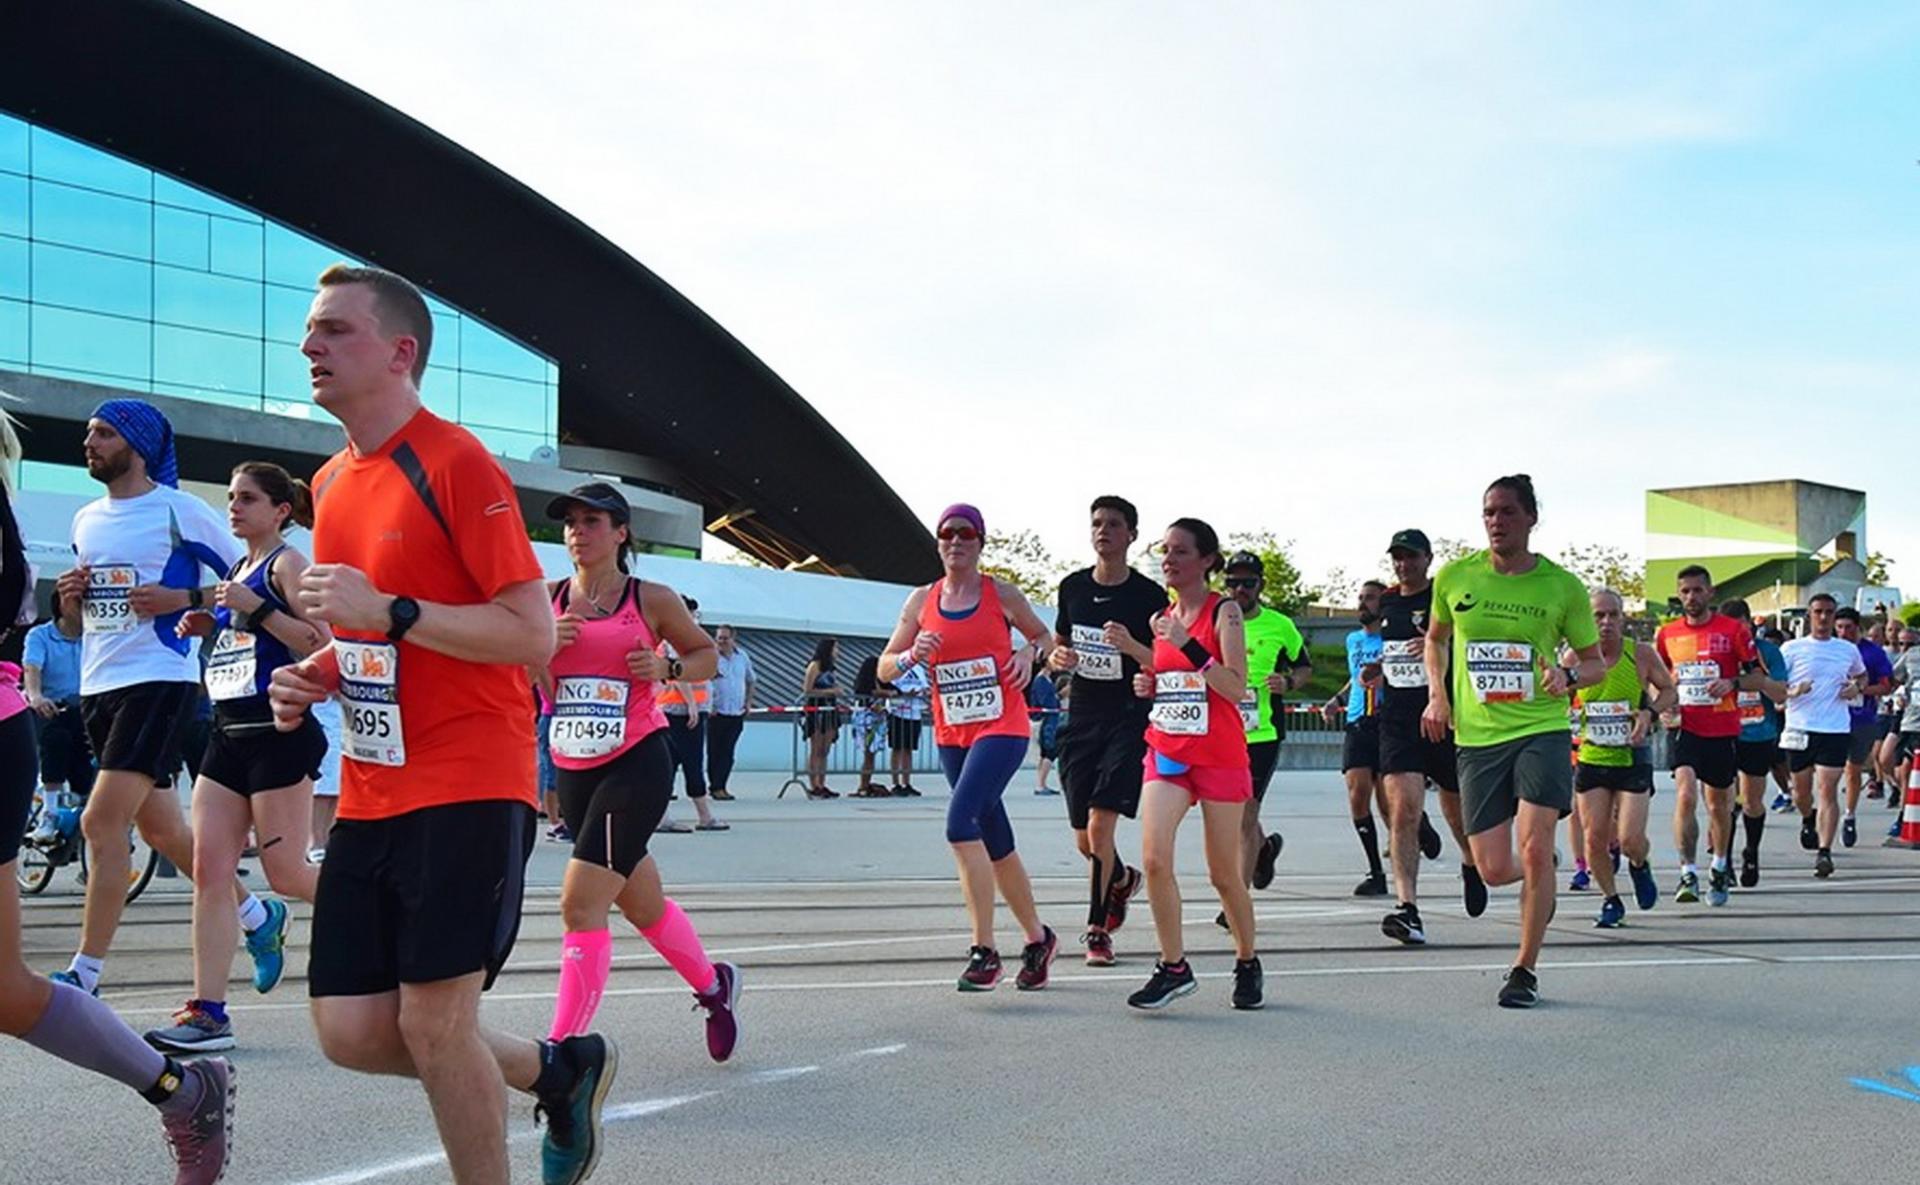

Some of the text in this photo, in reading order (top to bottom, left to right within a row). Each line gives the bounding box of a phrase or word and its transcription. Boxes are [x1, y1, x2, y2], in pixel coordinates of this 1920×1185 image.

[84, 602, 131, 619] 0359
[1483, 600, 1548, 619] REHAZENTER
[1470, 645, 1503, 660] ING
[938, 665, 969, 682] ING
[558, 683, 591, 701] ING
[1475, 675, 1523, 691] 871-1
[946, 690, 997, 711] F4729
[347, 706, 391, 738] 695
[554, 721, 621, 739] F10494
